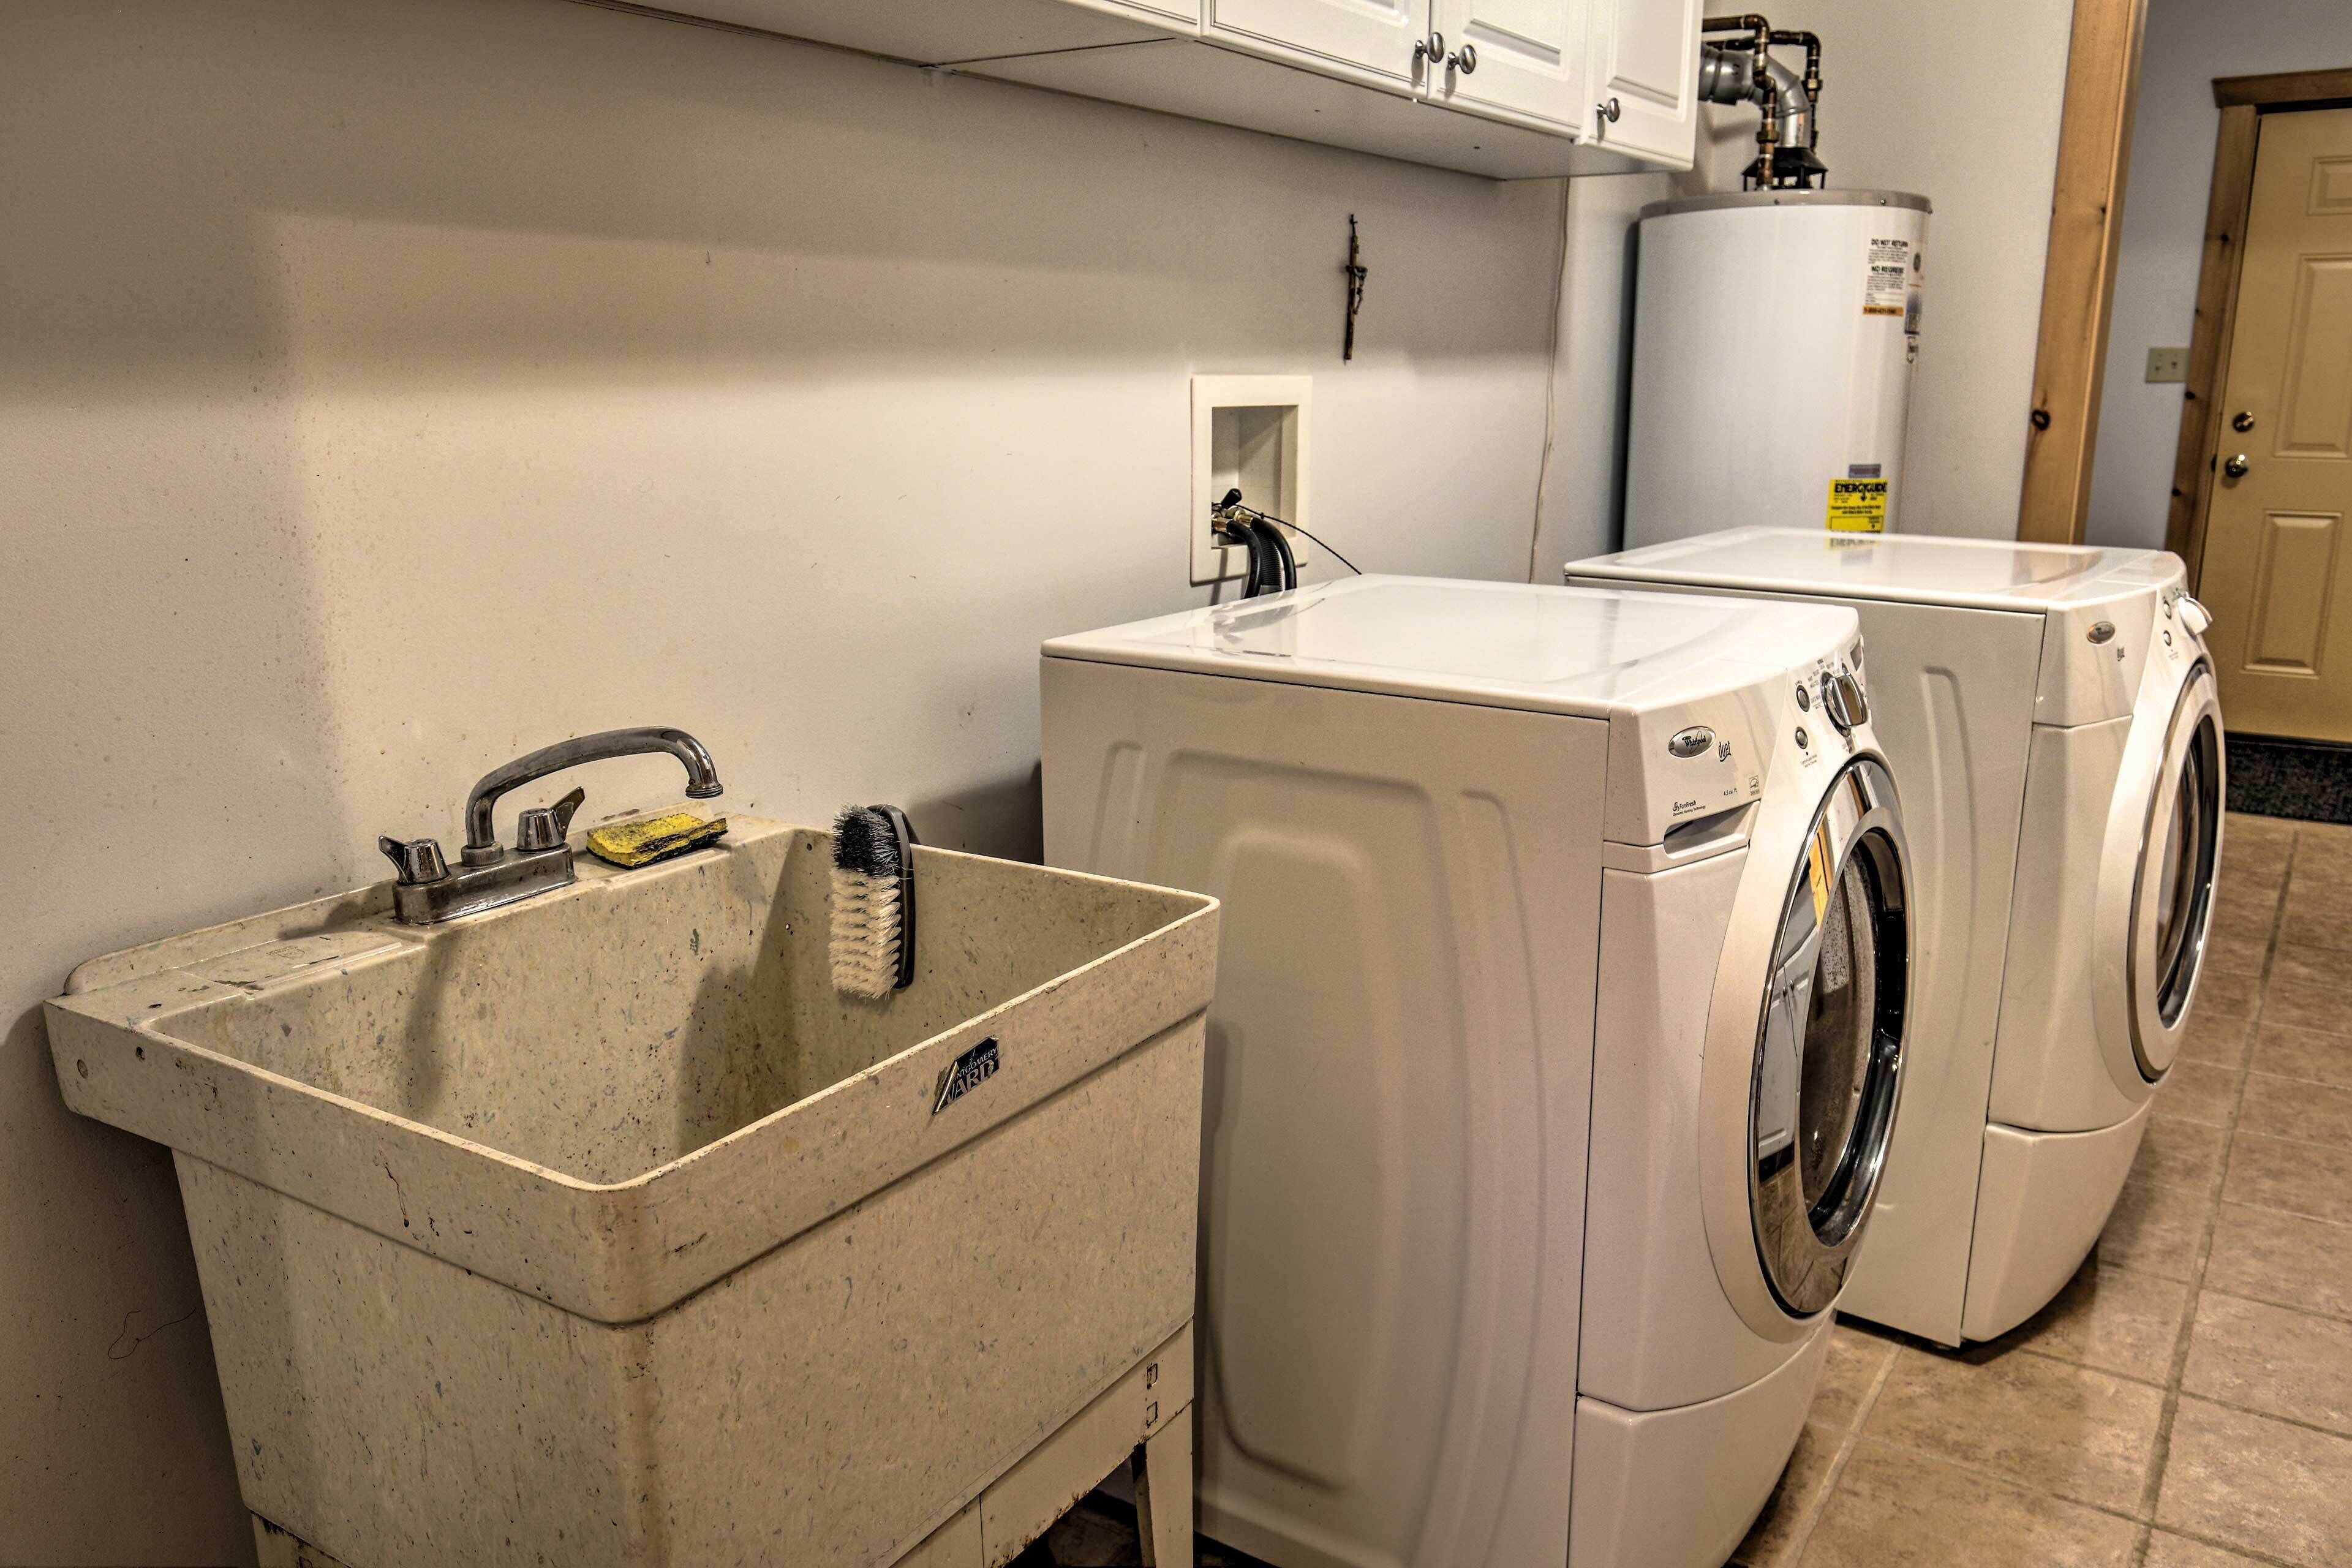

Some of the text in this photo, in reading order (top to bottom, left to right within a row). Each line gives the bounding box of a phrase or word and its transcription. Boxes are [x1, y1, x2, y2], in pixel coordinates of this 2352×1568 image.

[1685, 736, 1706, 747] Whirlpool
[1718, 741, 1732, 762] duet
[1679, 800, 1696, 809] FanFresh
[956, 1047, 997, 1079] NTGOMERY
